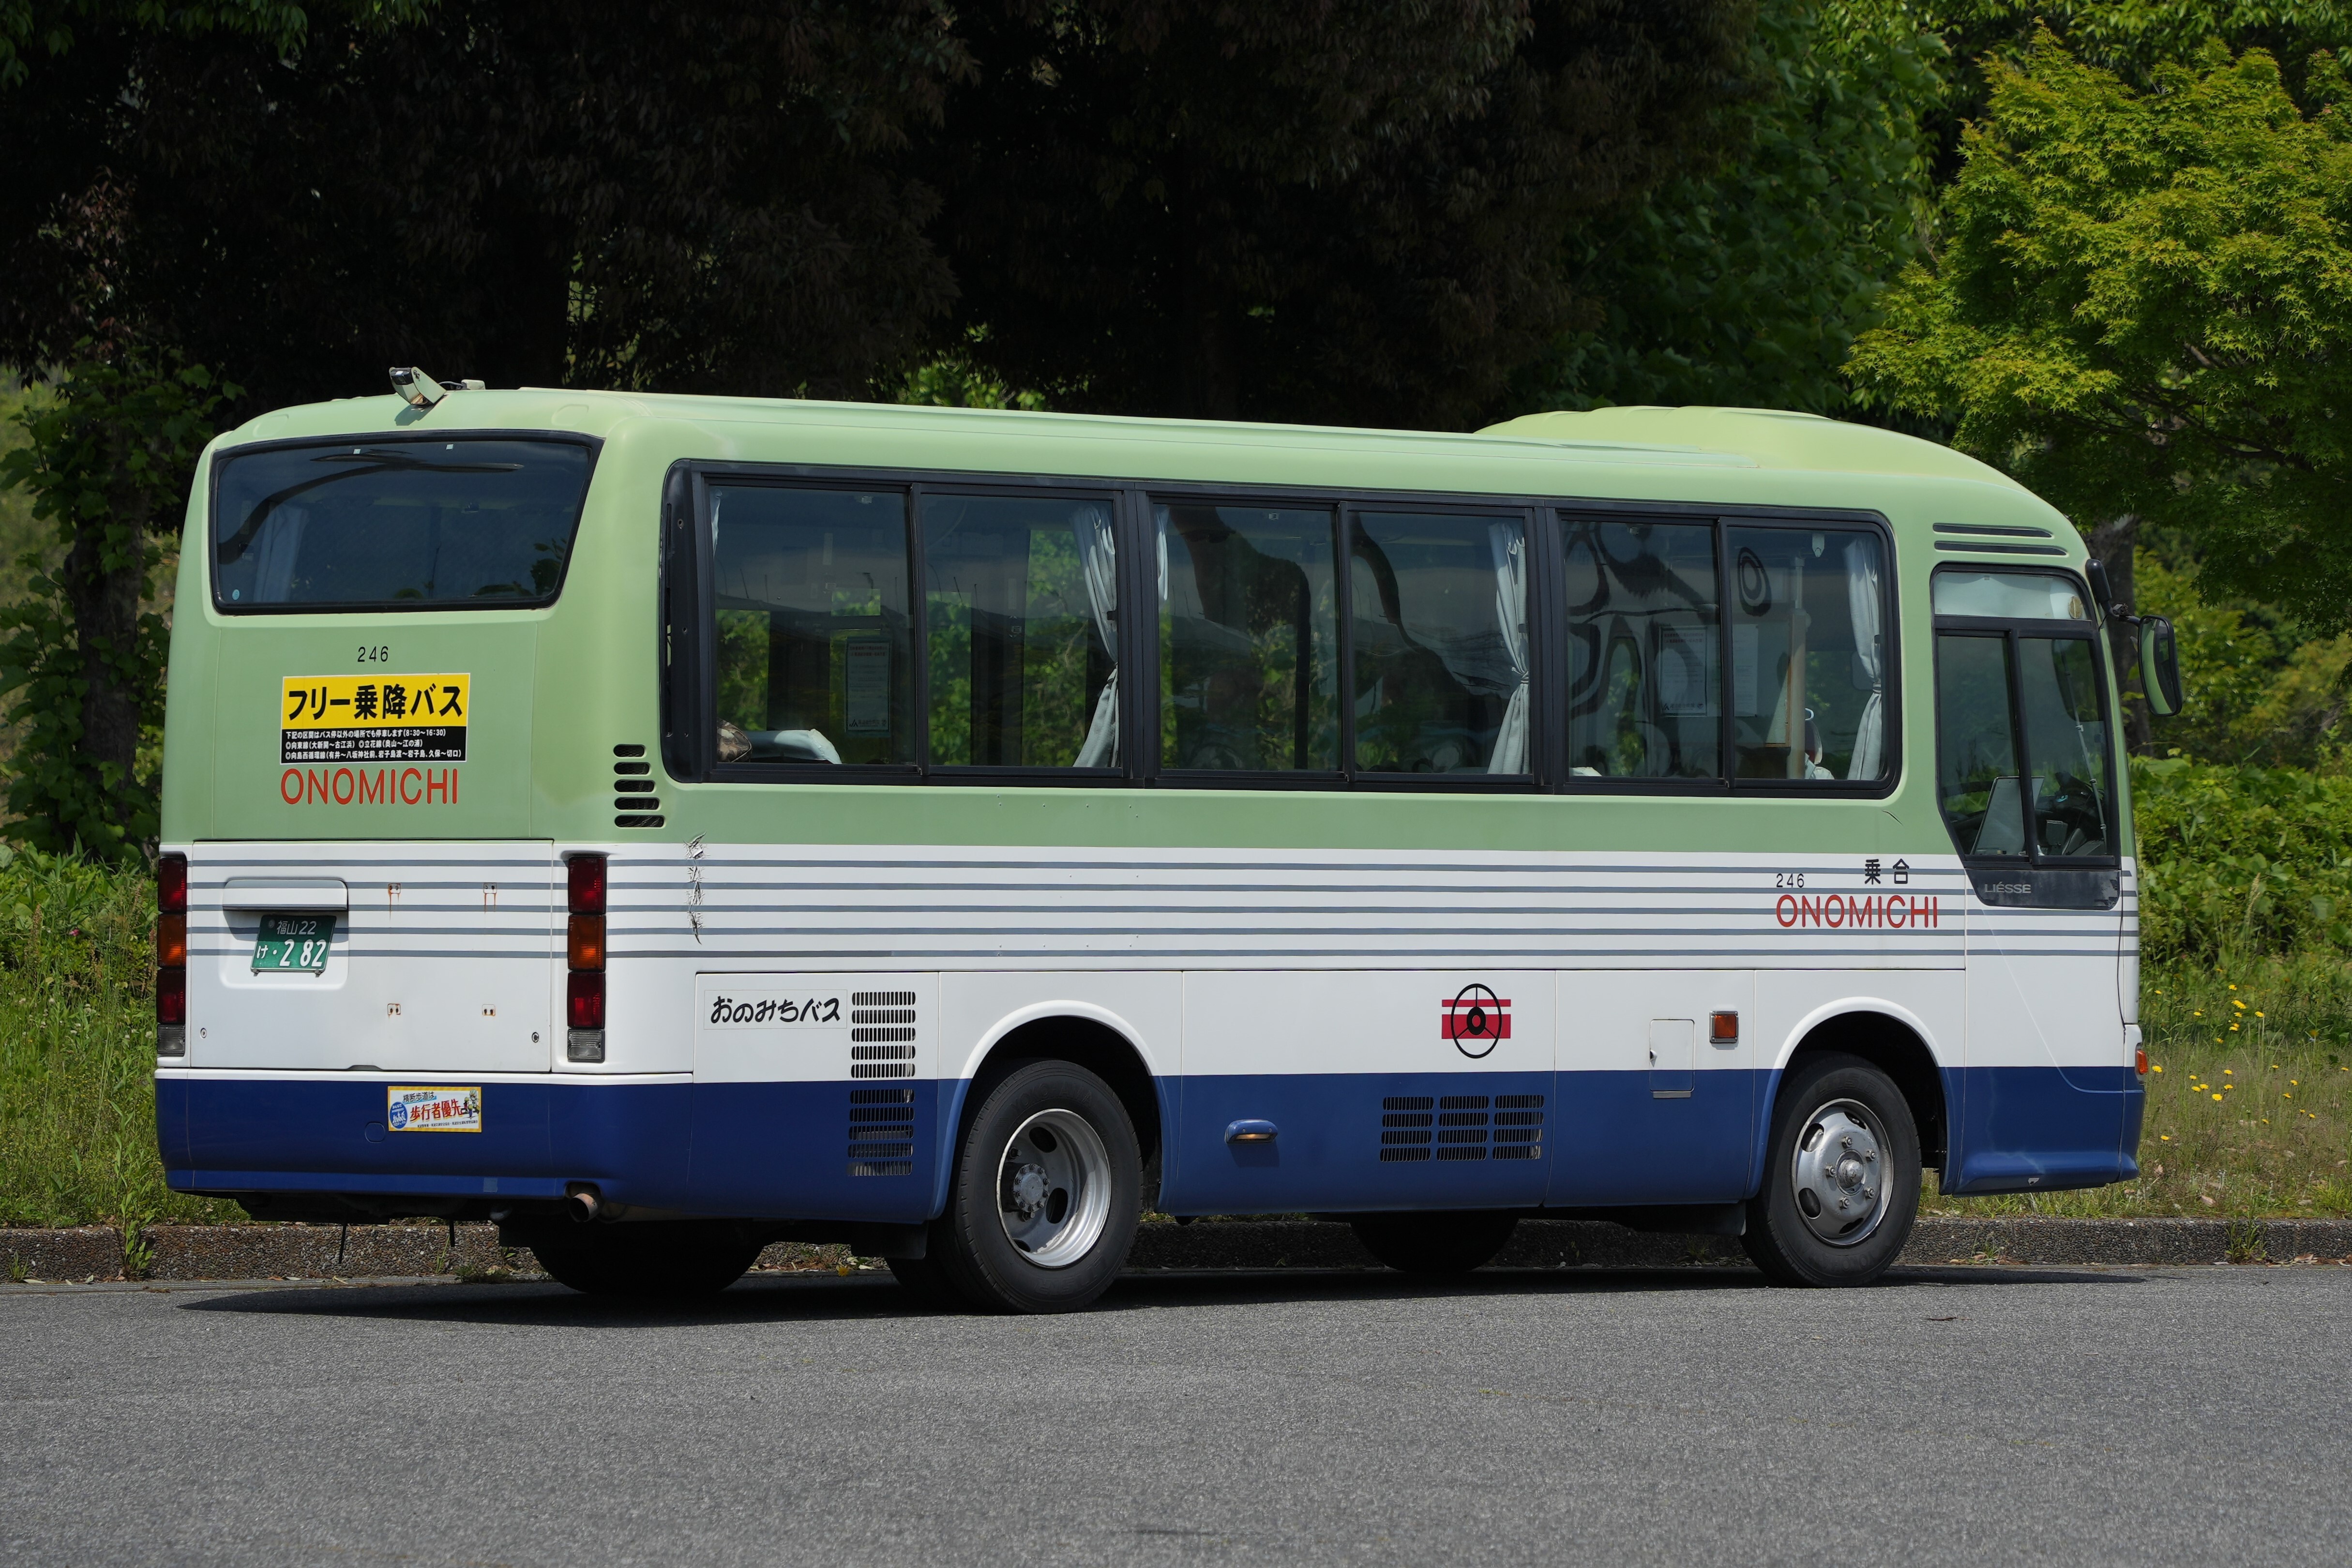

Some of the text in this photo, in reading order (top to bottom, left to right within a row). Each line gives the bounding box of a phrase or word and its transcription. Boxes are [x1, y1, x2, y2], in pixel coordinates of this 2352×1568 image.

[357, 646, 389, 662] 246
[288, 683, 463, 720] フリー乗降バス
[281, 768, 458, 805] ONOMICHI
[1776, 873, 1804, 888] 246
[1865, 859, 1910, 885] 乗合
[1984, 881, 2032, 893] LIÉSSE
[1776, 894, 1937, 928] ONOMICHI
[711, 995, 841, 1024] おのみちバス
[403, 1091, 435, 1103] 横断歩道は
[409, 1098, 463, 1122] 歩行者優先
